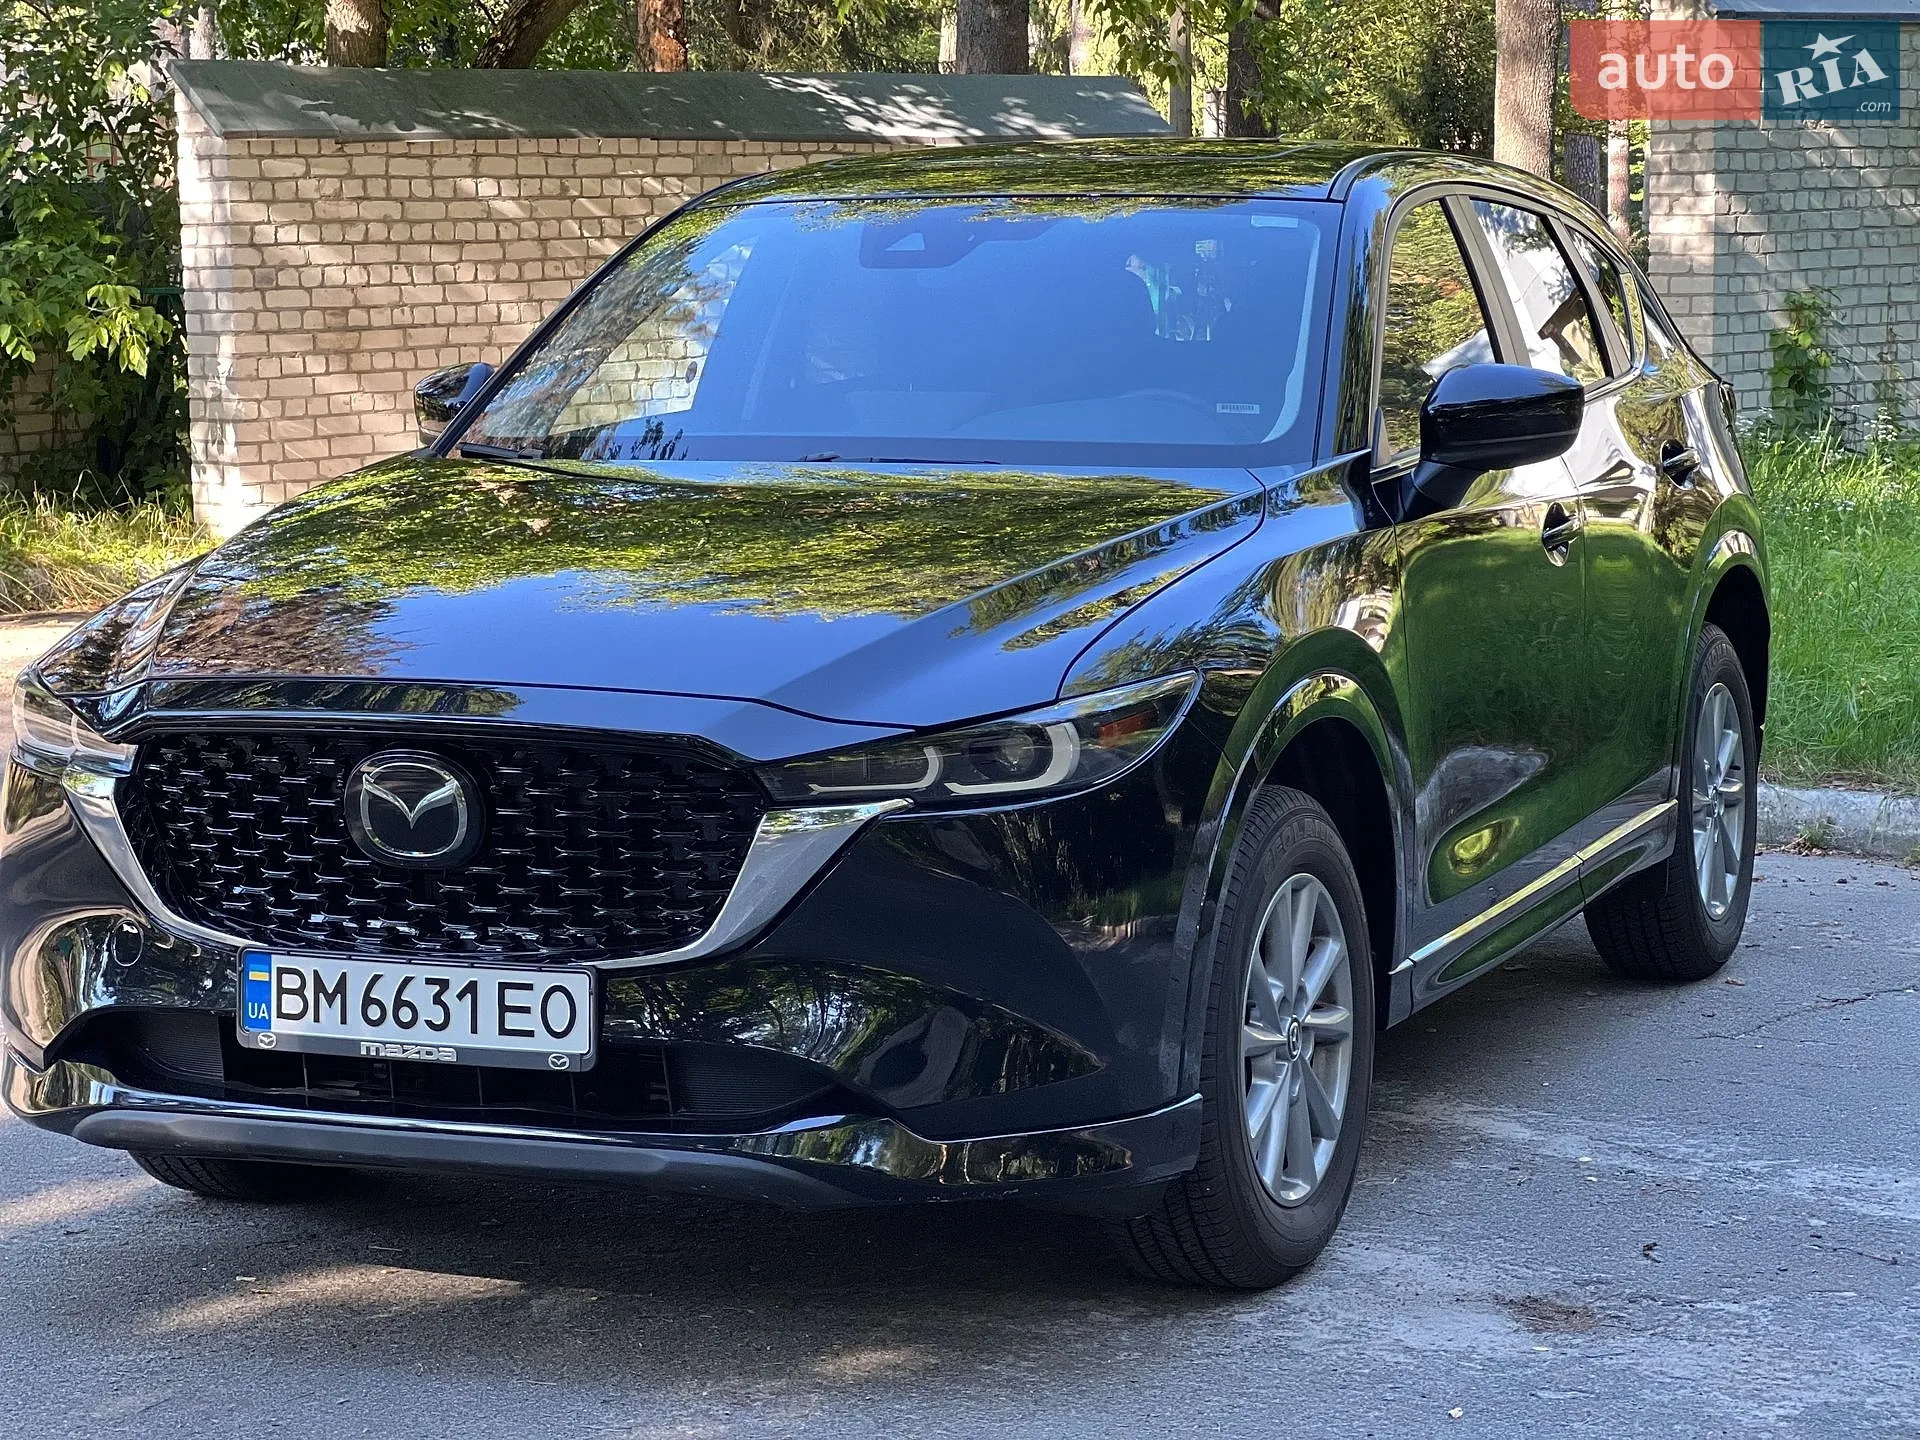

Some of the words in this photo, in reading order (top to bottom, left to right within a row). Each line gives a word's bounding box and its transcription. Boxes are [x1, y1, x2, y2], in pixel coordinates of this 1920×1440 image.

[248, 1002, 269, 1020] UA
[276, 966, 348, 1025] BM
[360, 973, 479, 1035] 6631
[497, 981, 578, 1039] EO
[360, 1041, 457, 1062] mazda
